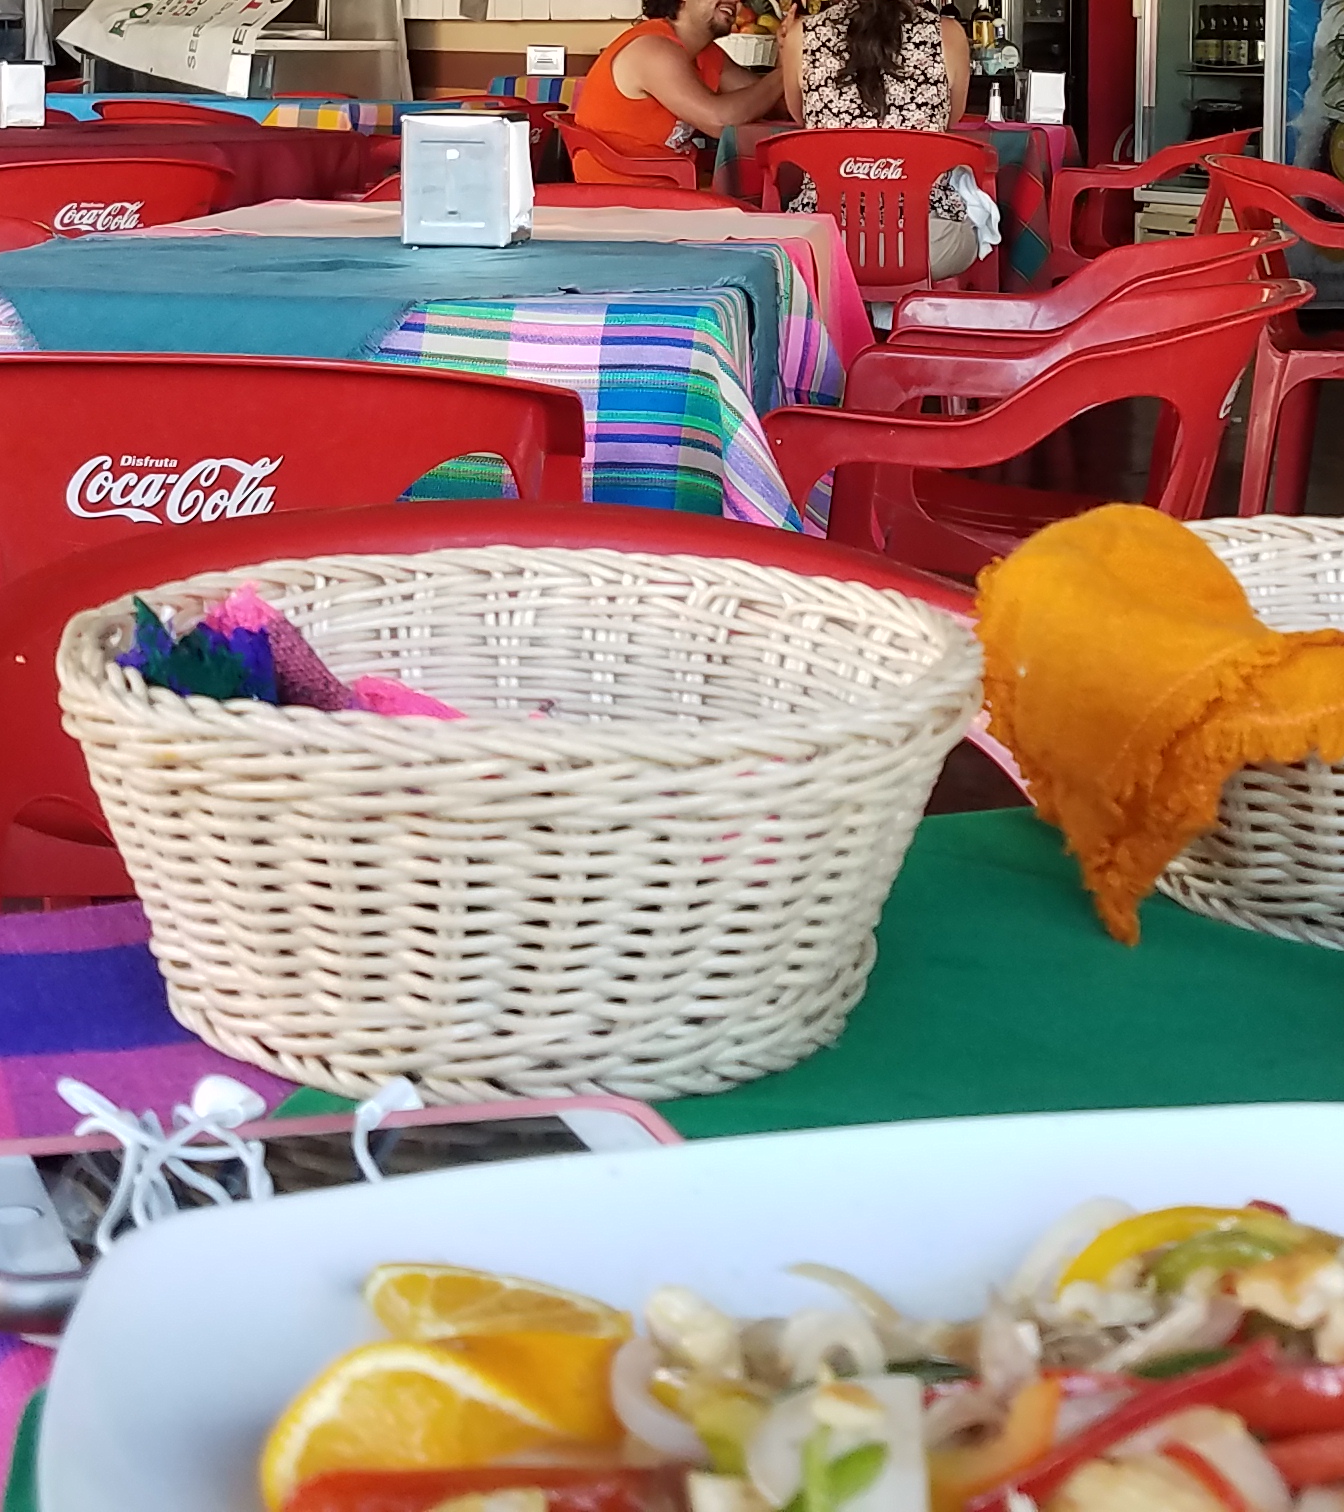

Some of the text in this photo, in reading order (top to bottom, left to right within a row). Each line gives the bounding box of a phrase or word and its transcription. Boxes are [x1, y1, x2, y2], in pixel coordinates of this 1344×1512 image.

[839, 157, 905, 180] Coca-Cola
[53, 200, 145, 231] Coca-Cola
[119, 455, 178, 468] Disfruta
[66, 455, 284, 524] Coca-Cola
